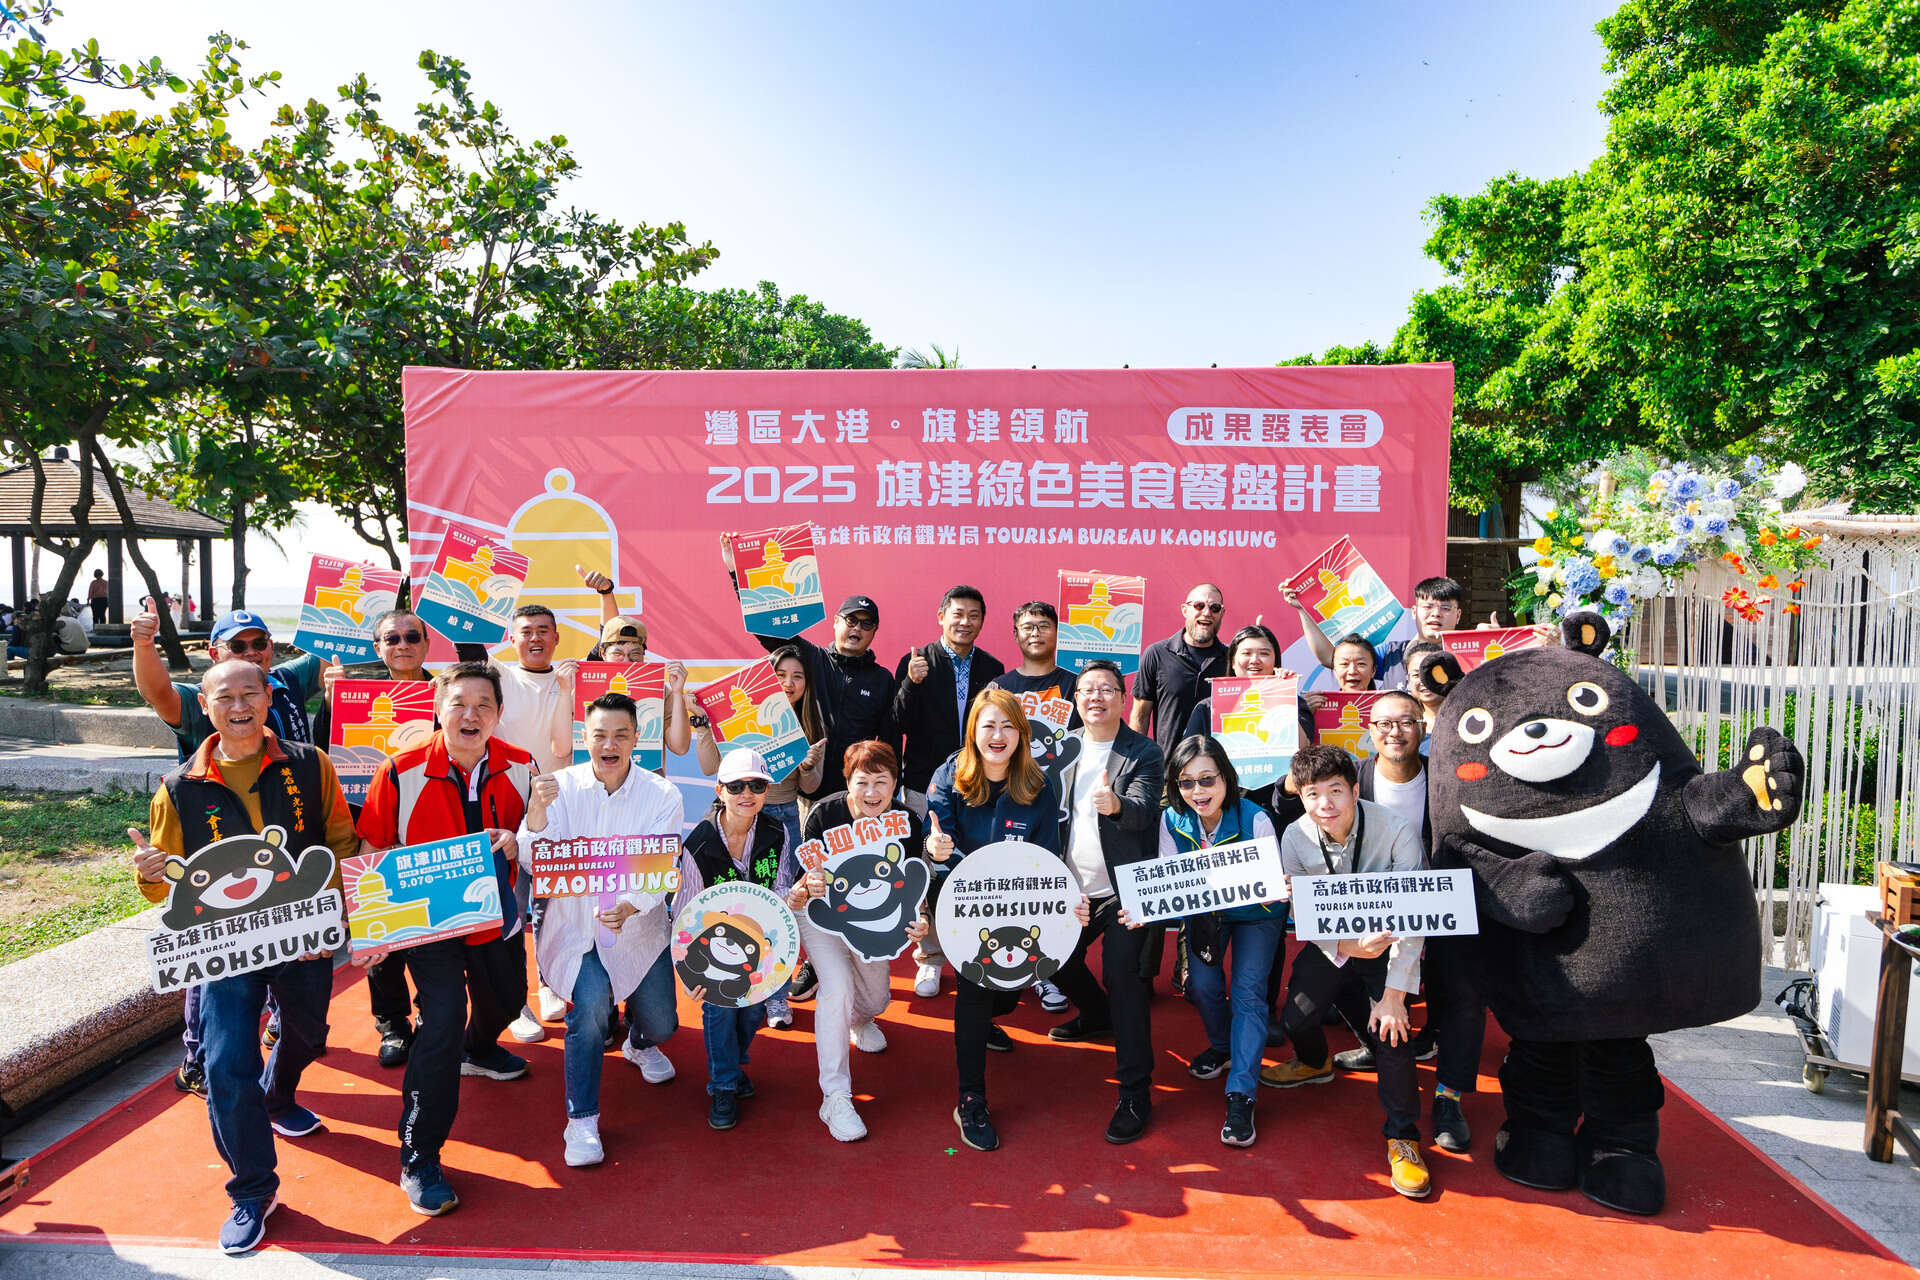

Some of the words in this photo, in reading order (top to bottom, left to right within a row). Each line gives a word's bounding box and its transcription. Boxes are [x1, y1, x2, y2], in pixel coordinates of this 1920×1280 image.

[1185, 413, 1368, 444] 成果發表會
[706, 465, 856, 504] 2025
[876, 459, 1381, 512] 旗津綠色美食餐盤計畫
[737, 540, 760, 549] CIJIN
[811, 525, 979, 546] 高雄市政府觀光局
[985, 526, 1074, 545] TOURISM
[1078, 527, 1156, 545] BUREAU
[1160, 528, 1276, 548] KAOHSIUNG
[318, 558, 344, 568] CIJIN
[1451, 641, 1480, 649] CIJIN
[582, 672, 607, 680] CIJIN
[340, 692, 370, 700] CIJIN
[702, 691, 725, 705] CIJIN
[1218, 686, 1241, 694] CIJIN
[396, 840, 481, 871] 旗津小旅行
[535, 837, 679, 860] 高雄市政府觀光局
[535, 863, 576, 872] TOURISM
[578, 861, 616, 871] BUREAU
[1132, 846, 1260, 883] 高雄市政府觀光局
[535, 871, 679, 895] KAOHSIUNG
[953, 876, 1067, 893] 高雄市政府觀光局
[1137, 884, 1173, 897] TOURISM
[1174, 877, 1207, 890] BUREAU
[1312, 876, 1454, 897] 高雄市政府觀光局
[954, 901, 1067, 918] KAOHSIUNG
[1141, 881, 1267, 917] KAOHSIUNG
[1315, 902, 1354, 912] TOURISM
[1357, 900, 1393, 910] BUREAU
[150, 894, 337, 955] 高雄市政府觀光局
[699, 885, 778, 907] KAOHSIUNG
[779, 908, 797, 958] TRAVEL
[1317, 913, 1457, 934] KAOHSIUNG
[157, 952, 198, 965] TOURISM
[200, 941, 236, 955] BUREAU
[158, 926, 340, 989] KAOHSIUNG
